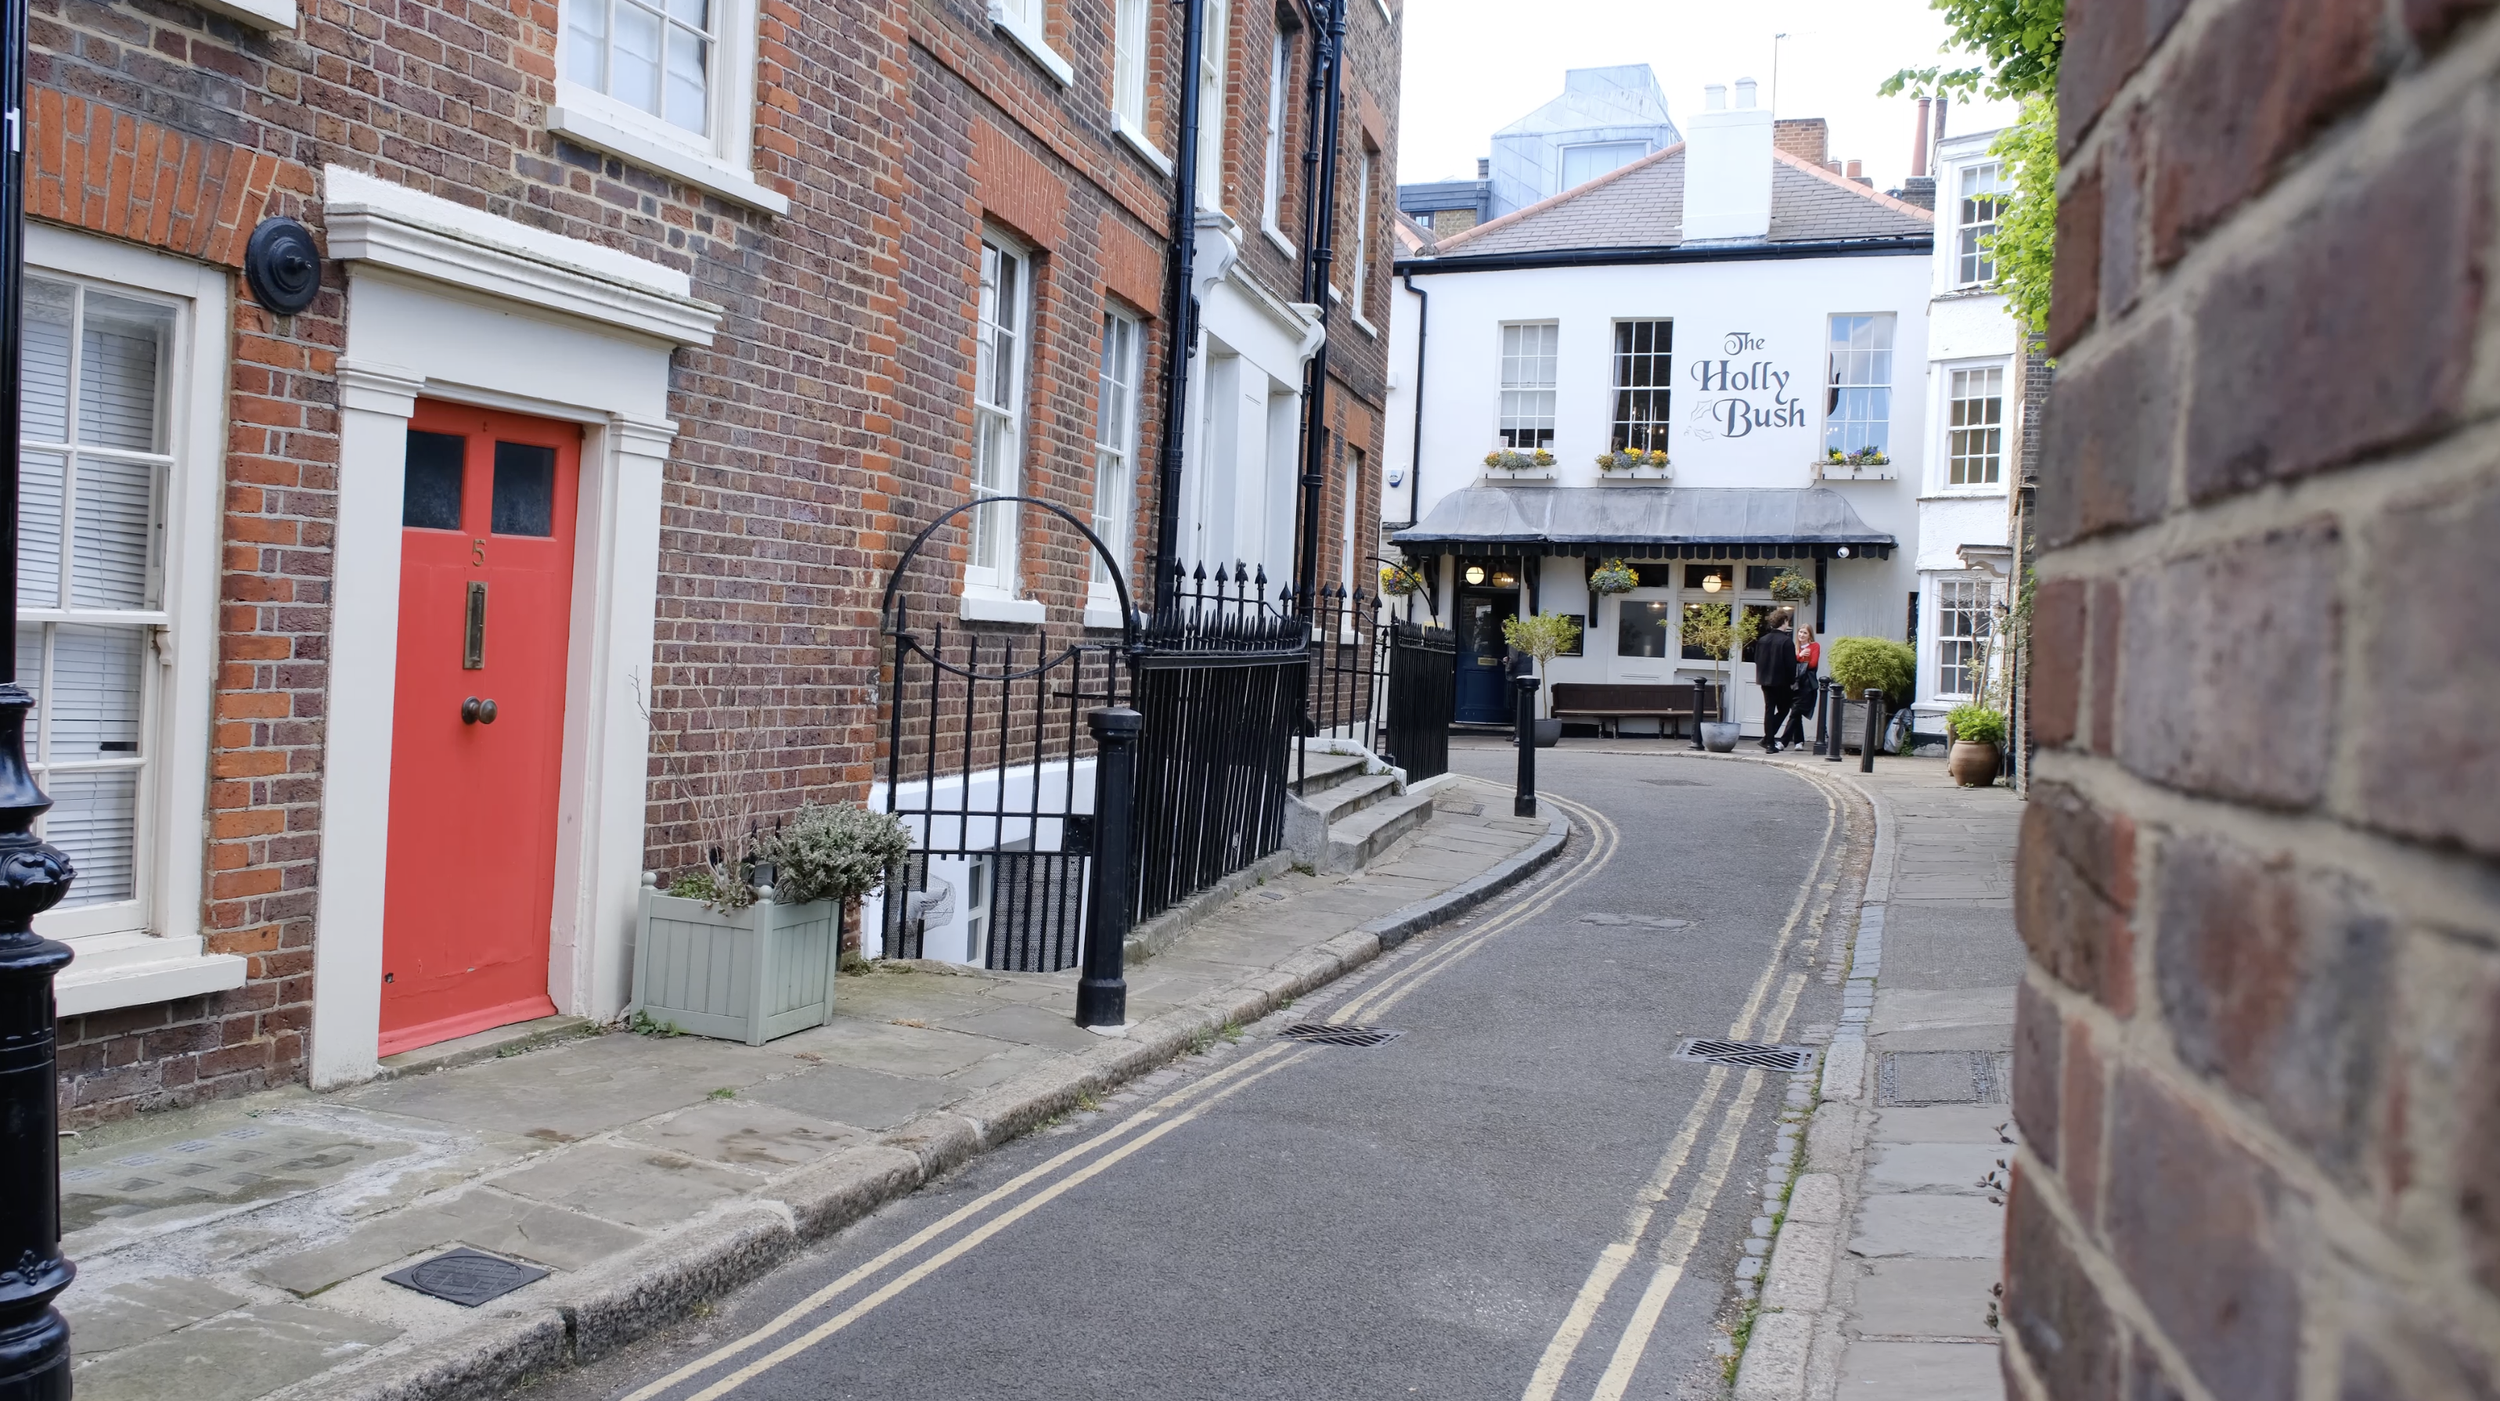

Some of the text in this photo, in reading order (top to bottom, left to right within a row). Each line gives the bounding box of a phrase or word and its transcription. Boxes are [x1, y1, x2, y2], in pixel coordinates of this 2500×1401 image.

[1723, 331, 1766, 356] The
[1690, 359, 1790, 406] Holly
[1712, 397, 1807, 439] Bush
[472, 538, 487, 567] 5
